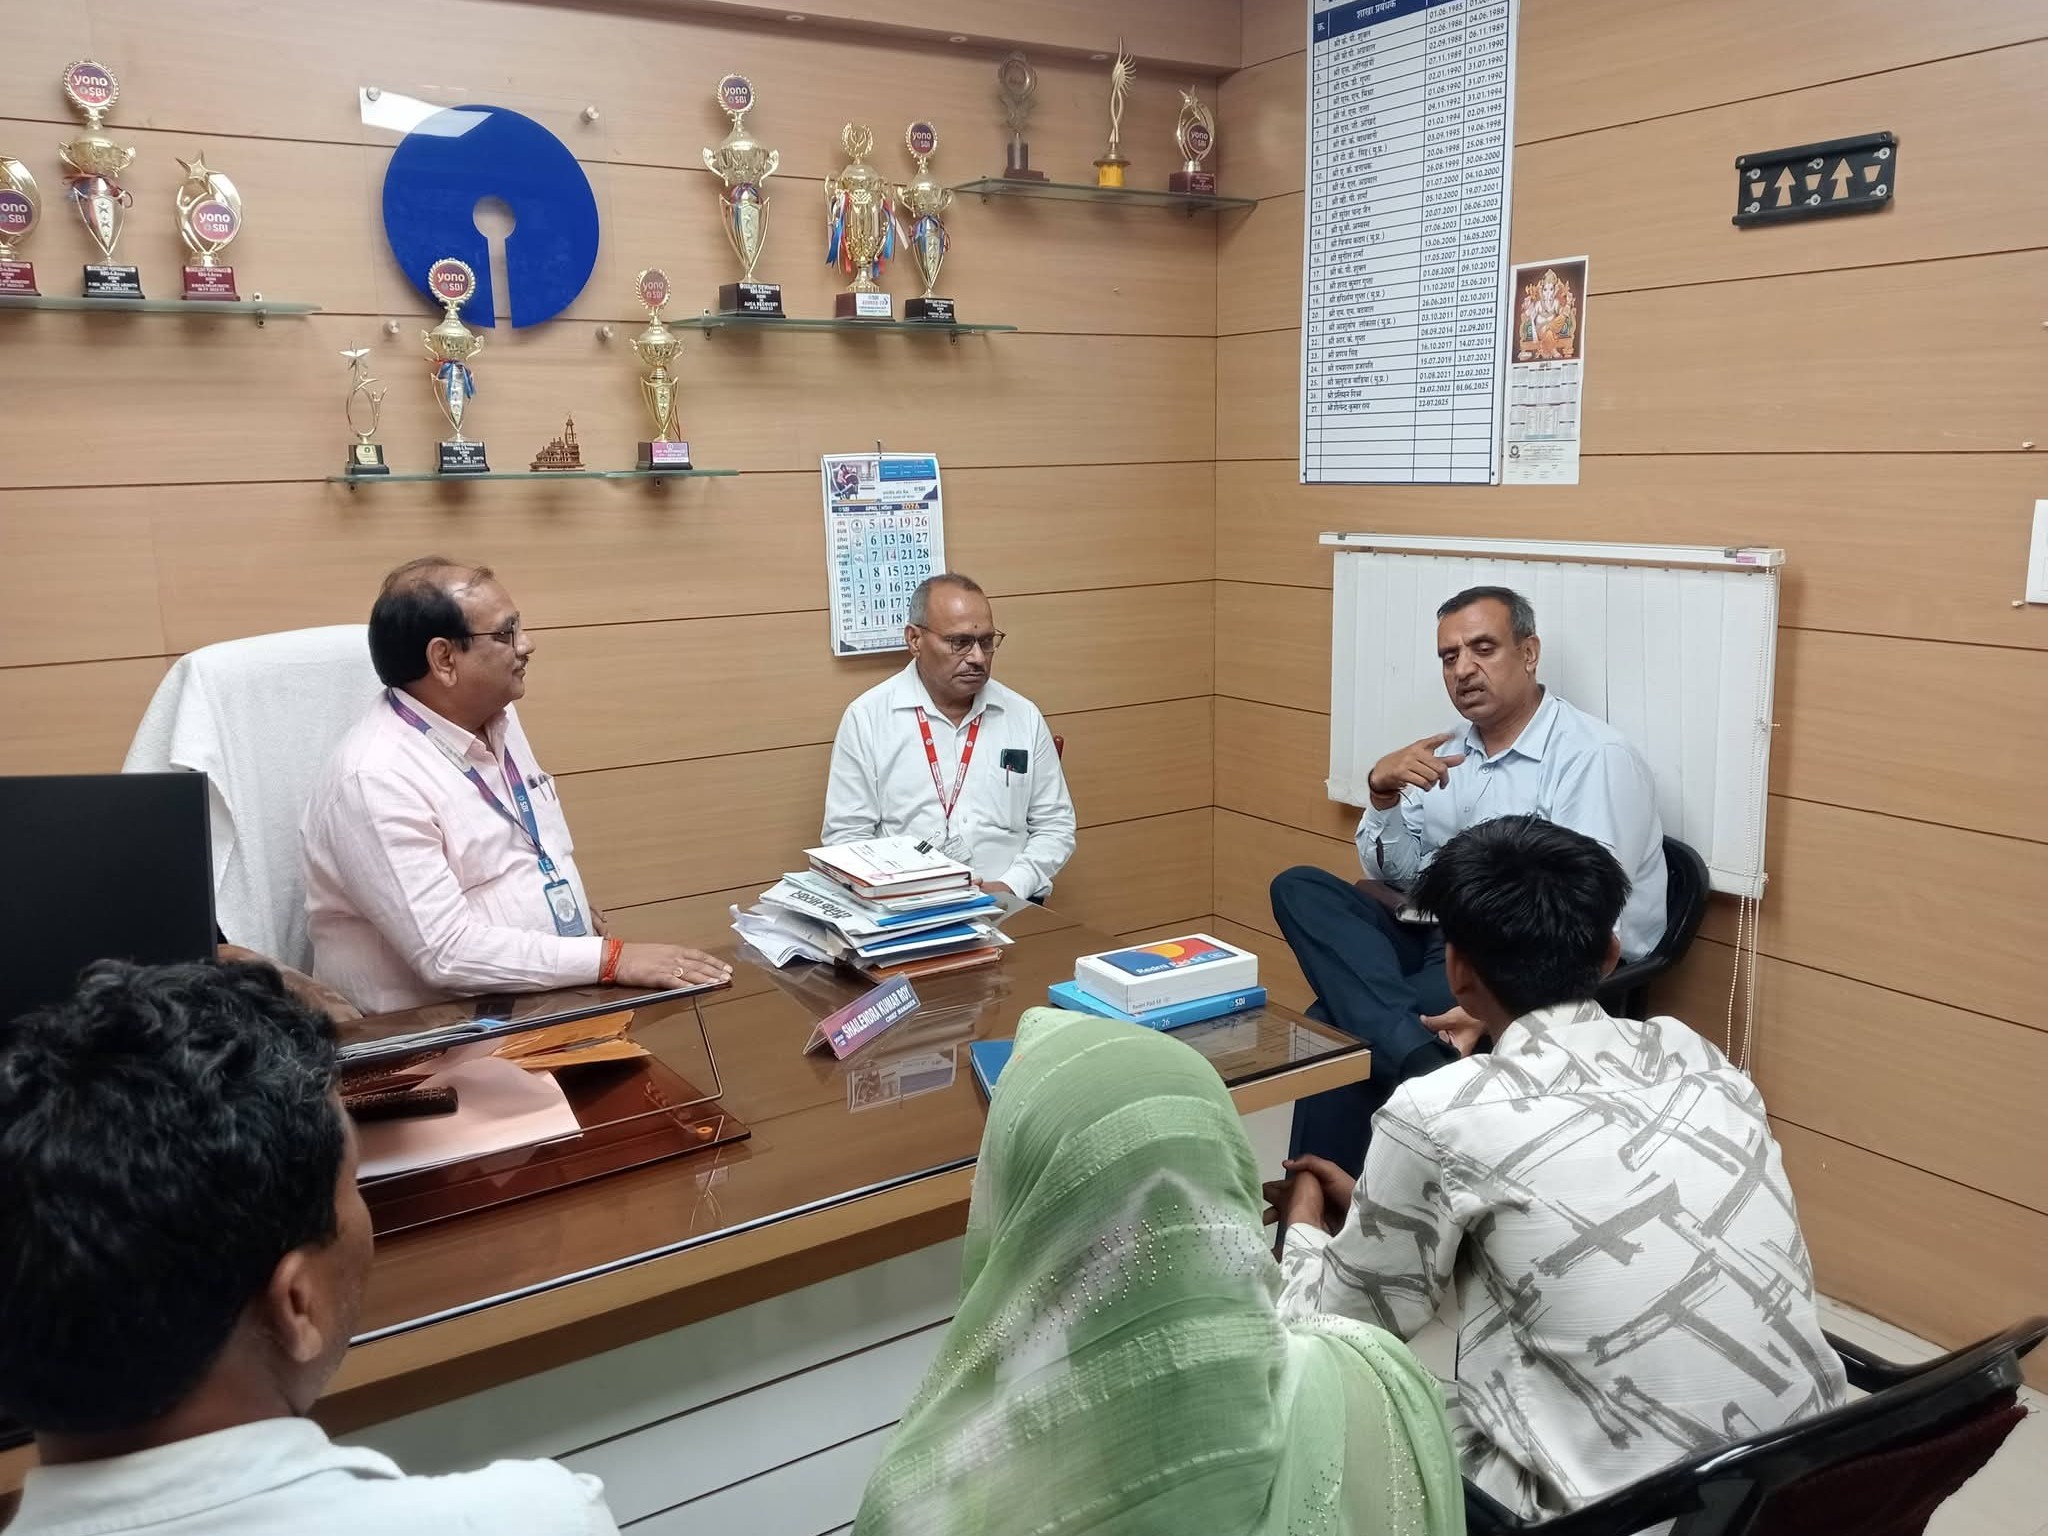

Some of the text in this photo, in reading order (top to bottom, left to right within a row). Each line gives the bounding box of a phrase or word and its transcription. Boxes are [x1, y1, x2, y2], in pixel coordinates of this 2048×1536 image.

[1356, 6, 1374, 18] शाखा
[73, 73, 108, 88] yono
[88, 87, 106, 98] SBI
[724, 86, 748, 98] yono
[735, 95, 747, 104] SBI
[912, 130, 932, 141] yono
[0, 203, 28, 213] ono
[8, 213, 26, 224] SBI
[199, 212, 231, 226] yono
[212, 223, 228, 232] SBI
[437, 271, 465, 285] yono
[448, 283, 463, 292] SBI
[642, 280, 664, 293] yono
[870, 516, 928, 529] 5 12 19 26
[871, 532, 928, 545] 6 13 20 27
[872, 548, 929, 561] 7 14 21 28
[859, 564, 930, 578] 1 8 15 22 29
[860, 581, 916, 594] 2 9 16 23
[861, 598, 901, 610] 3 10 17
[862, 614, 902, 626] 4 11 18
[841, 1004, 881, 1040] SHAILENDRA
[876, 991, 901, 1016] KUMAR
[896, 984, 911, 1003] ROY
